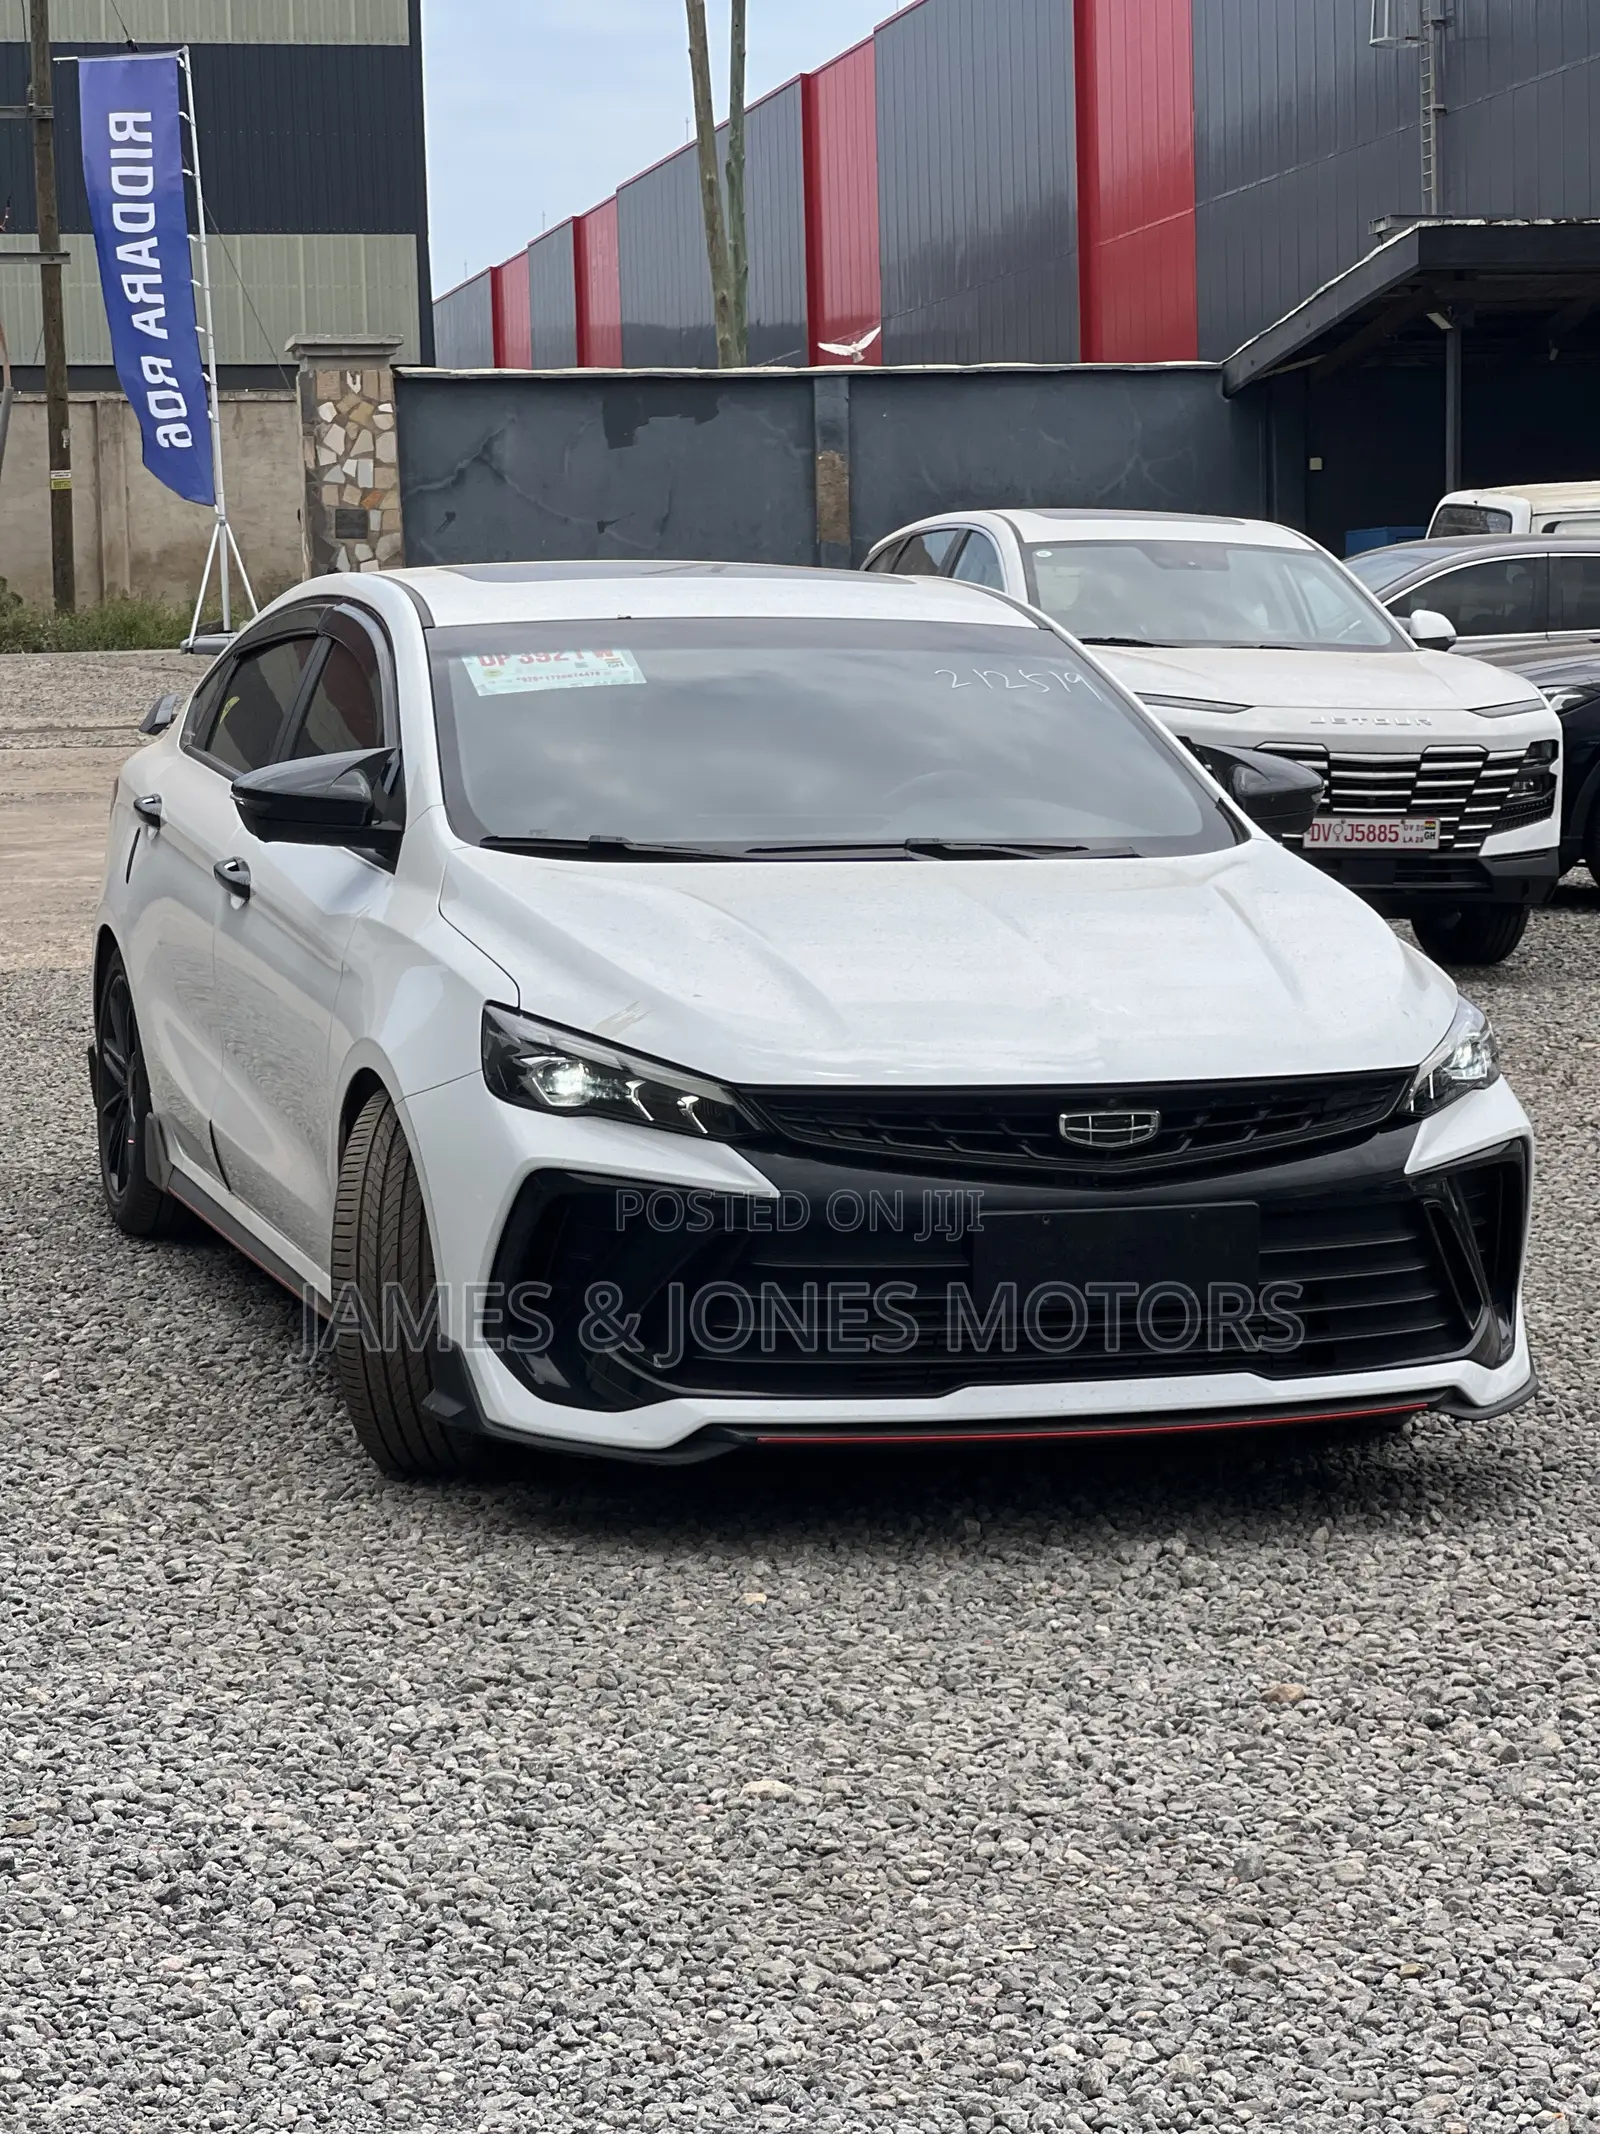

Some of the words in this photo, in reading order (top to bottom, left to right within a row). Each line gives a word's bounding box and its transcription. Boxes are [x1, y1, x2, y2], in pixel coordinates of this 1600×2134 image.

[934, 668, 1103, 702] 212519
[1310, 715, 1433, 727] JETOUR
[1344, 823, 1400, 843] J5885
[1424, 831, 1436, 840] GH
